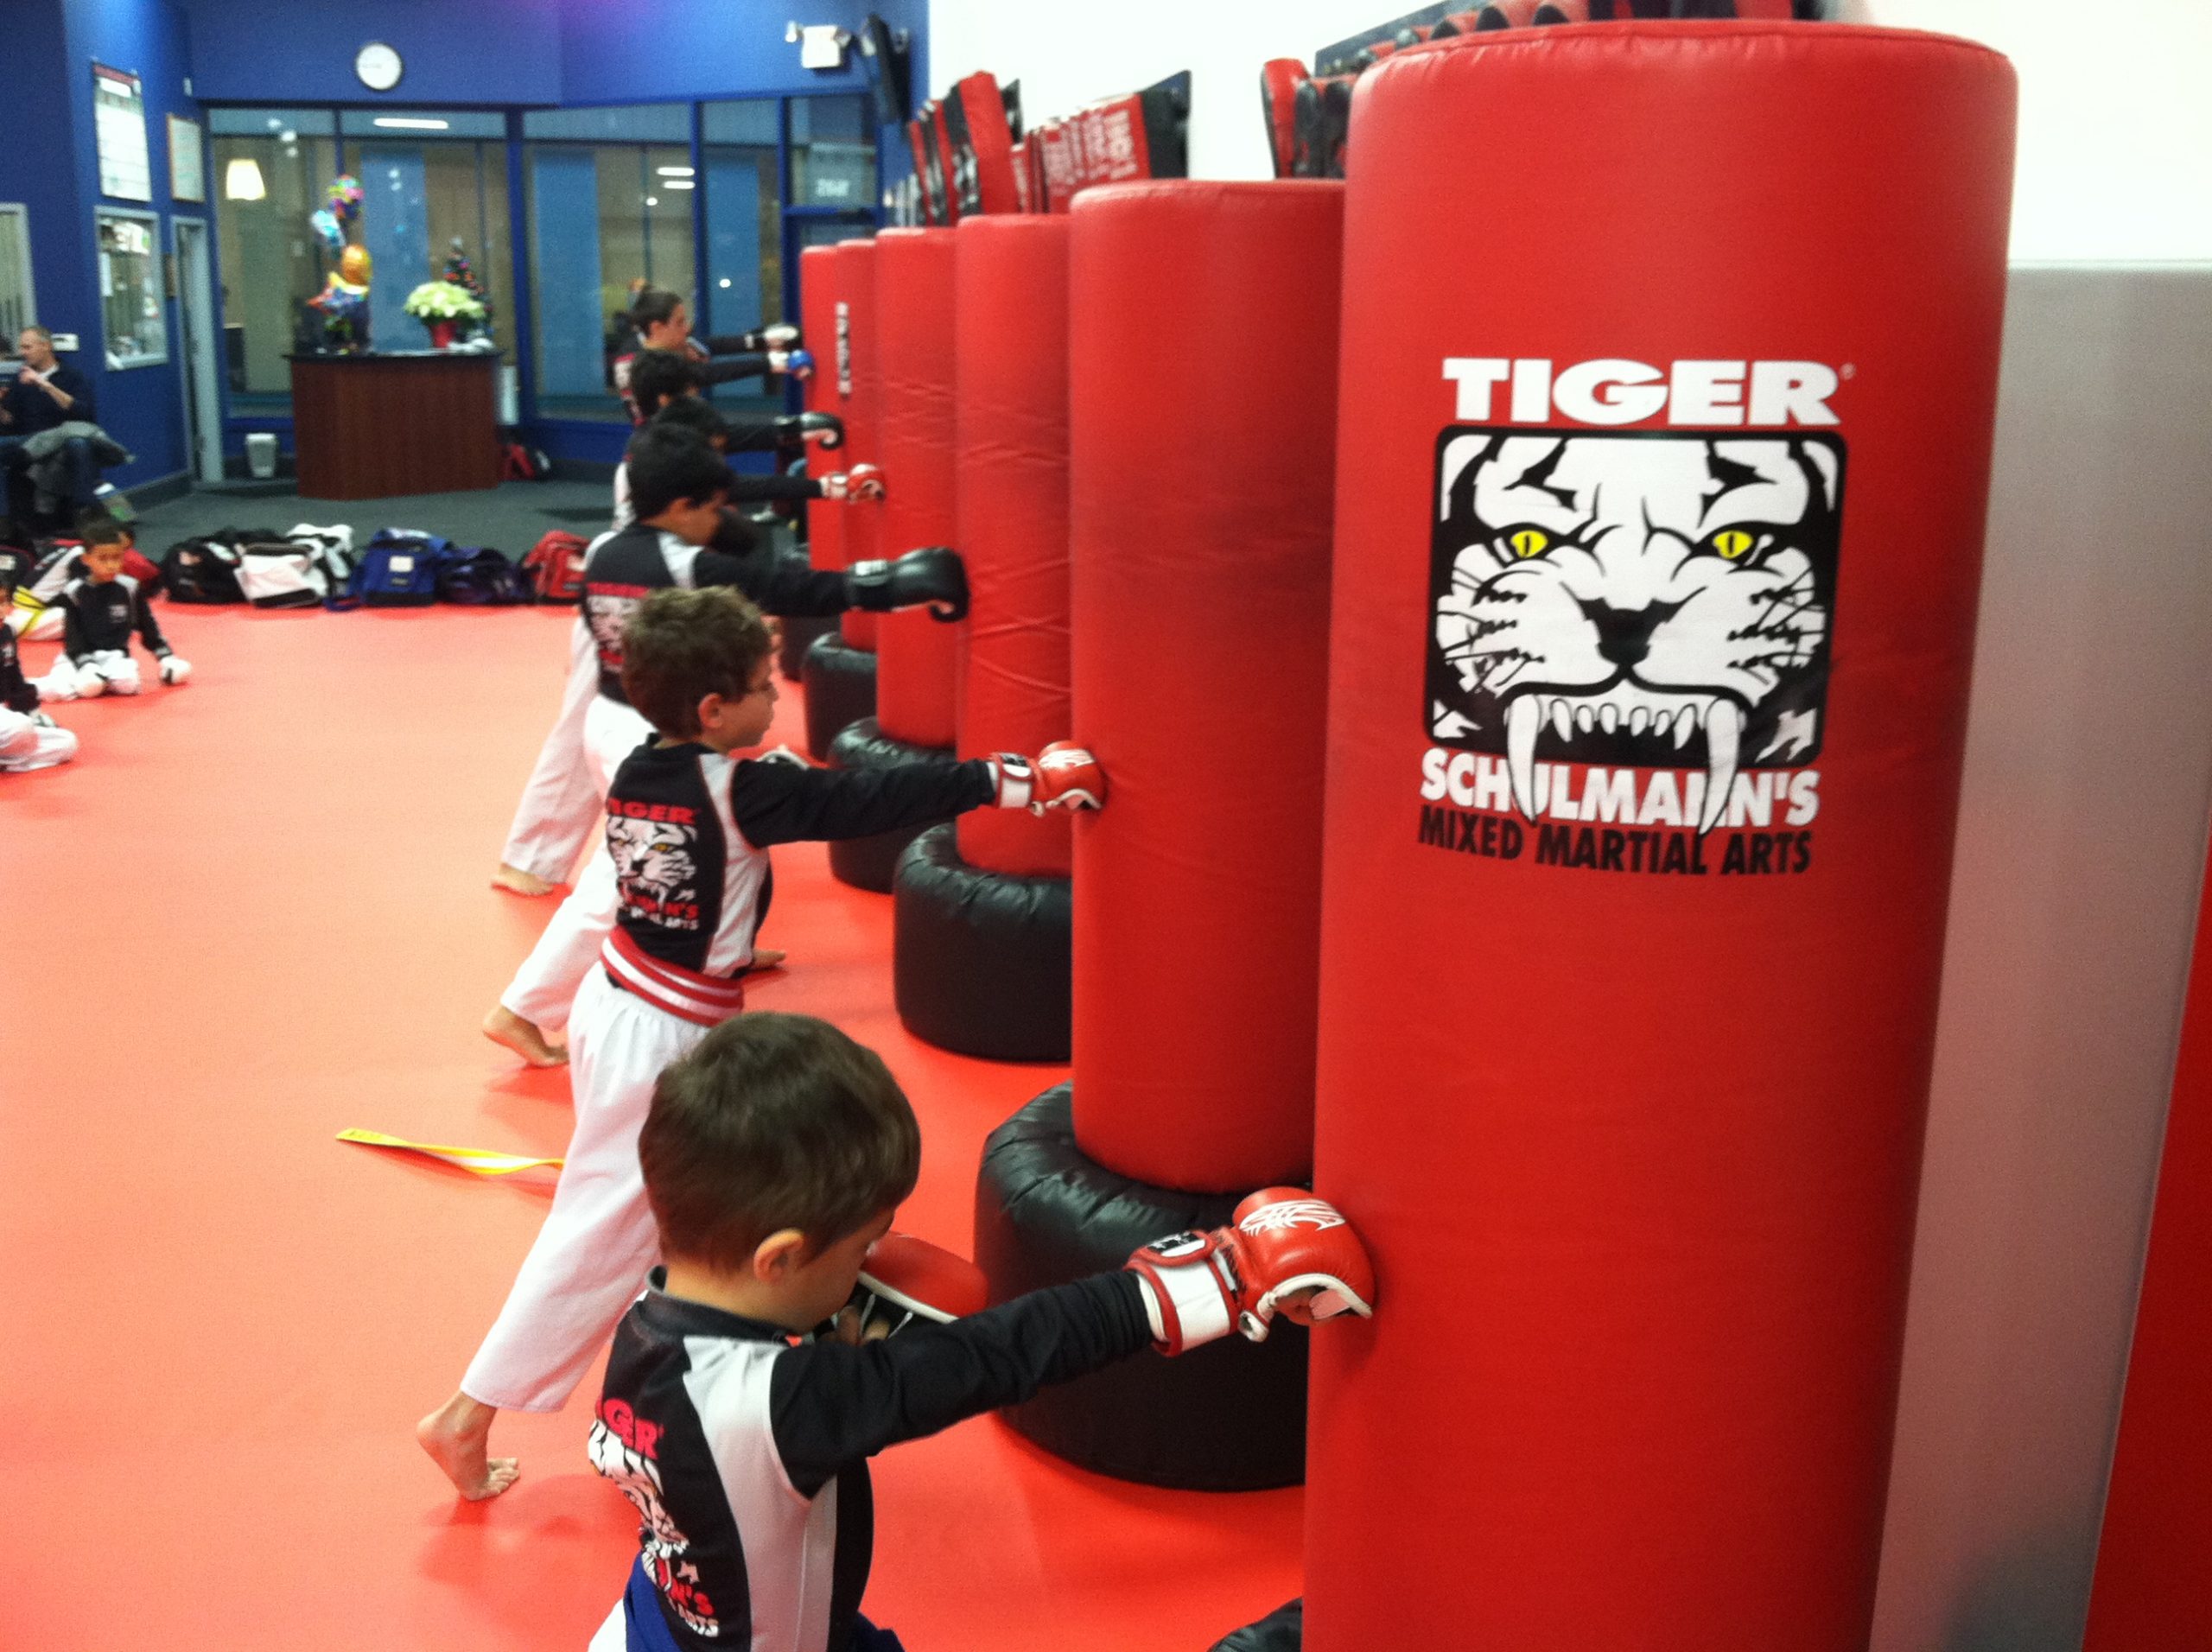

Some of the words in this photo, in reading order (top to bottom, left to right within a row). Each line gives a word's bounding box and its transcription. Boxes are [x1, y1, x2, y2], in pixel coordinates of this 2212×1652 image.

[1442, 357, 1841, 426] TIGER
[607, 797, 696, 825] IGER
[1417, 804, 1524, 861] MIXED
[1534, 823, 1709, 875] MARTIAL
[1719, 830, 1813, 875] ARTS
